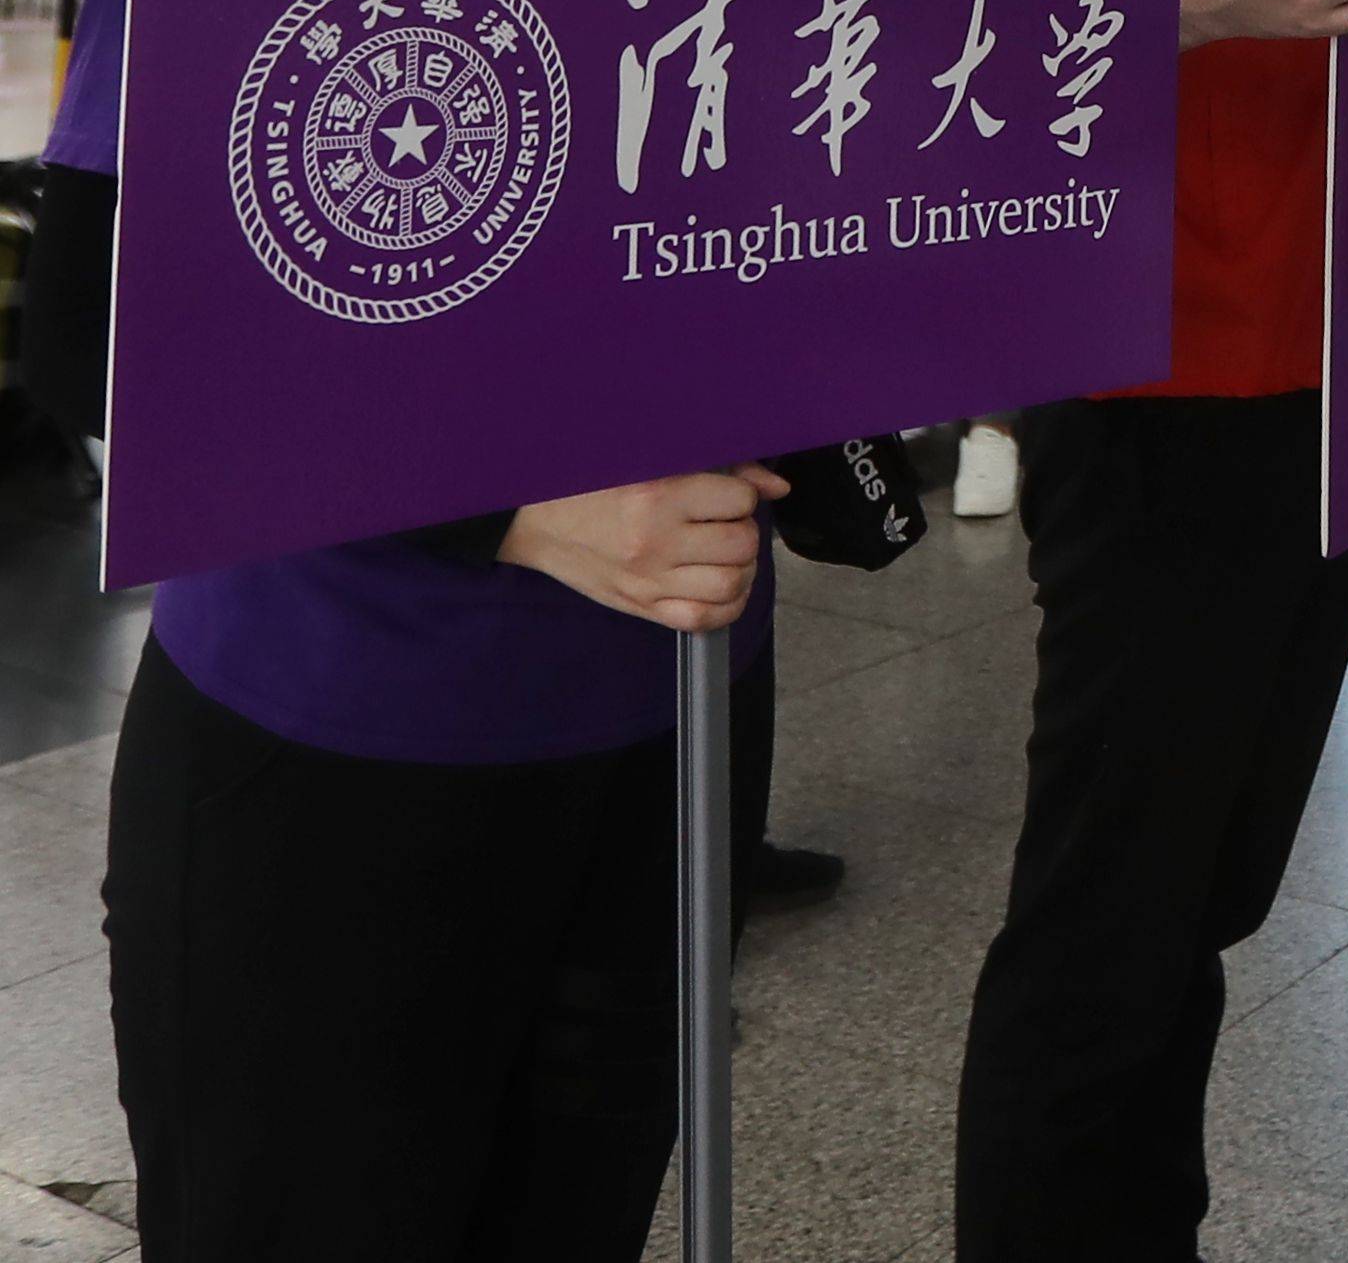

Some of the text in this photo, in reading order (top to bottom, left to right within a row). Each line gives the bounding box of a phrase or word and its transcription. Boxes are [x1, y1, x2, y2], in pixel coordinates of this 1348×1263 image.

[266, 98, 329, 263] TSINGHUA
[472, 87, 541, 246] UNIVERSITY
[612, 178, 1120, 284] Tsinghua University
